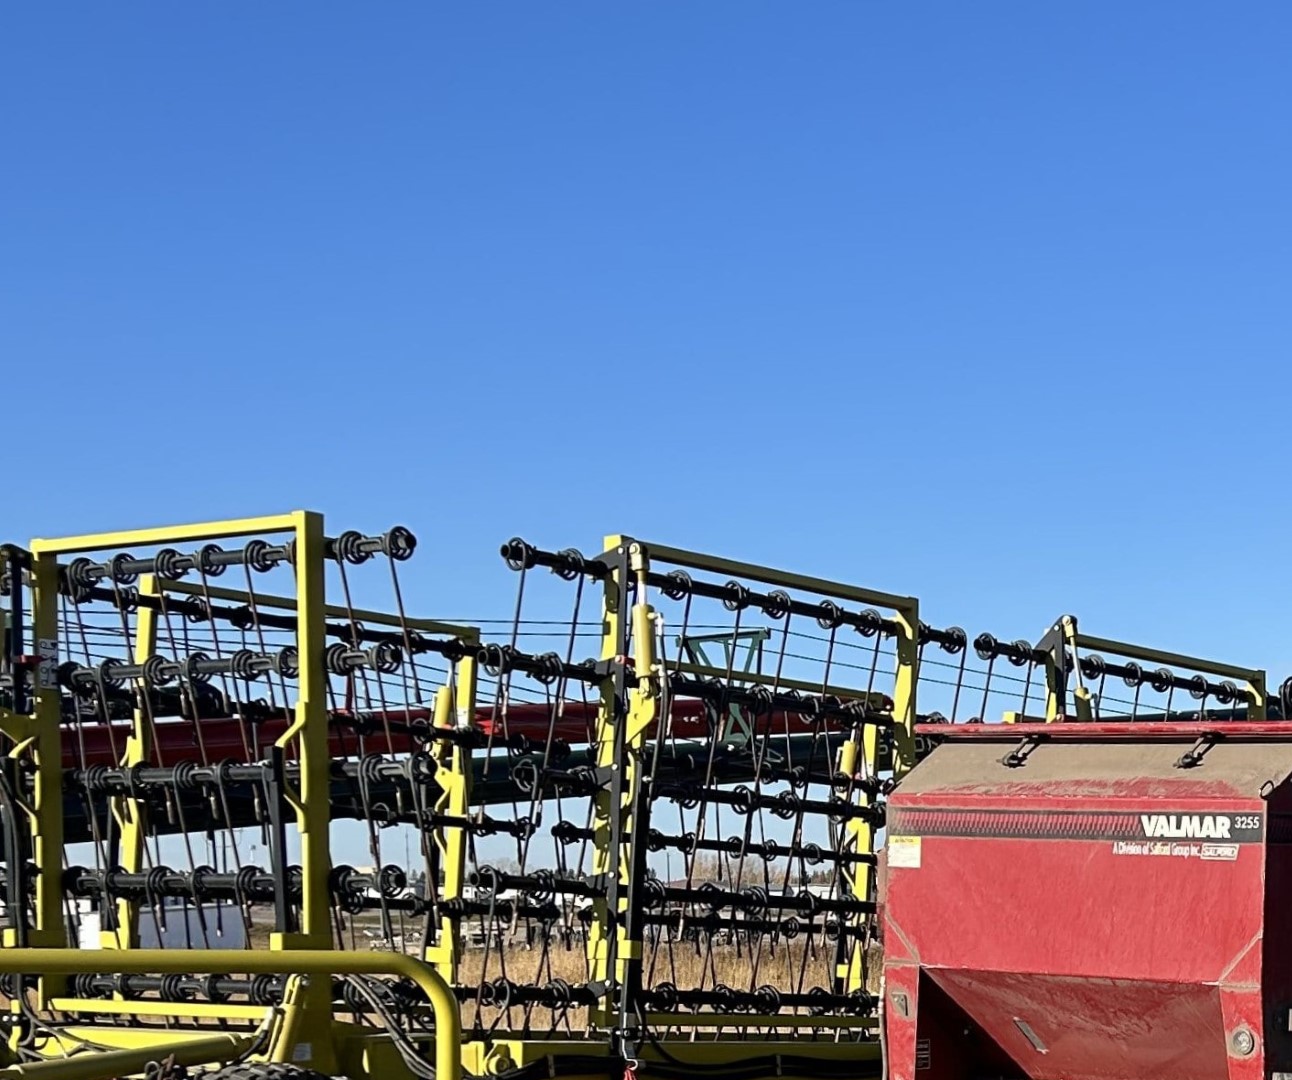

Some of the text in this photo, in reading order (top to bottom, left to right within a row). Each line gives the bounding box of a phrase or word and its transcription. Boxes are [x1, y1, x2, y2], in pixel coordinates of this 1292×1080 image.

[1140, 814, 1260, 839] VALMAR 3255
[1112, 842, 1118, 854] A
[1119, 842, 1142, 855] Division
[1142, 842, 1150, 855] of
[1150, 842, 1171, 856] Salford
[1171, 843, 1190, 859] Group
